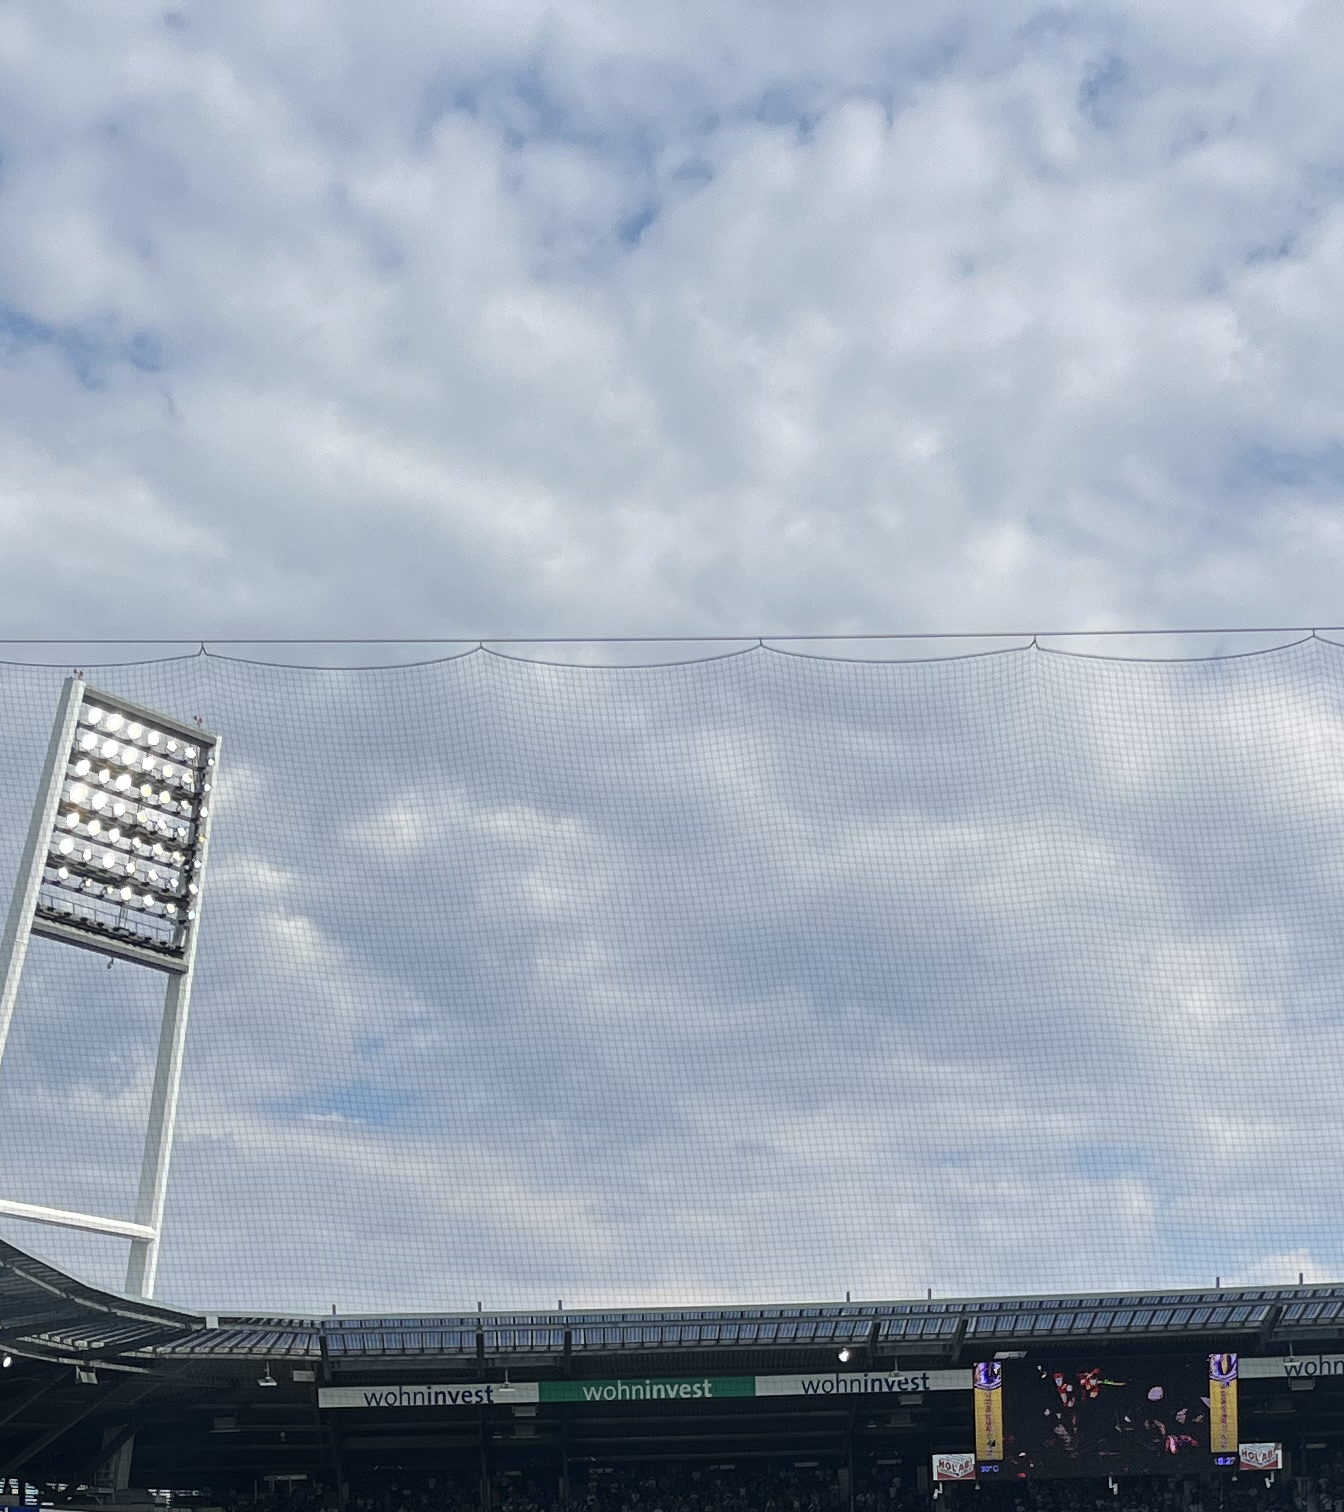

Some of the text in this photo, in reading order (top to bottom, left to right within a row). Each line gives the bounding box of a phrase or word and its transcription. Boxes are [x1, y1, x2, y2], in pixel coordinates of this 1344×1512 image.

[583, 1379, 712, 1401] wohninvest
[801, 1371, 930, 1395] wohninvest
[364, 1385, 494, 1407] wohninvest
